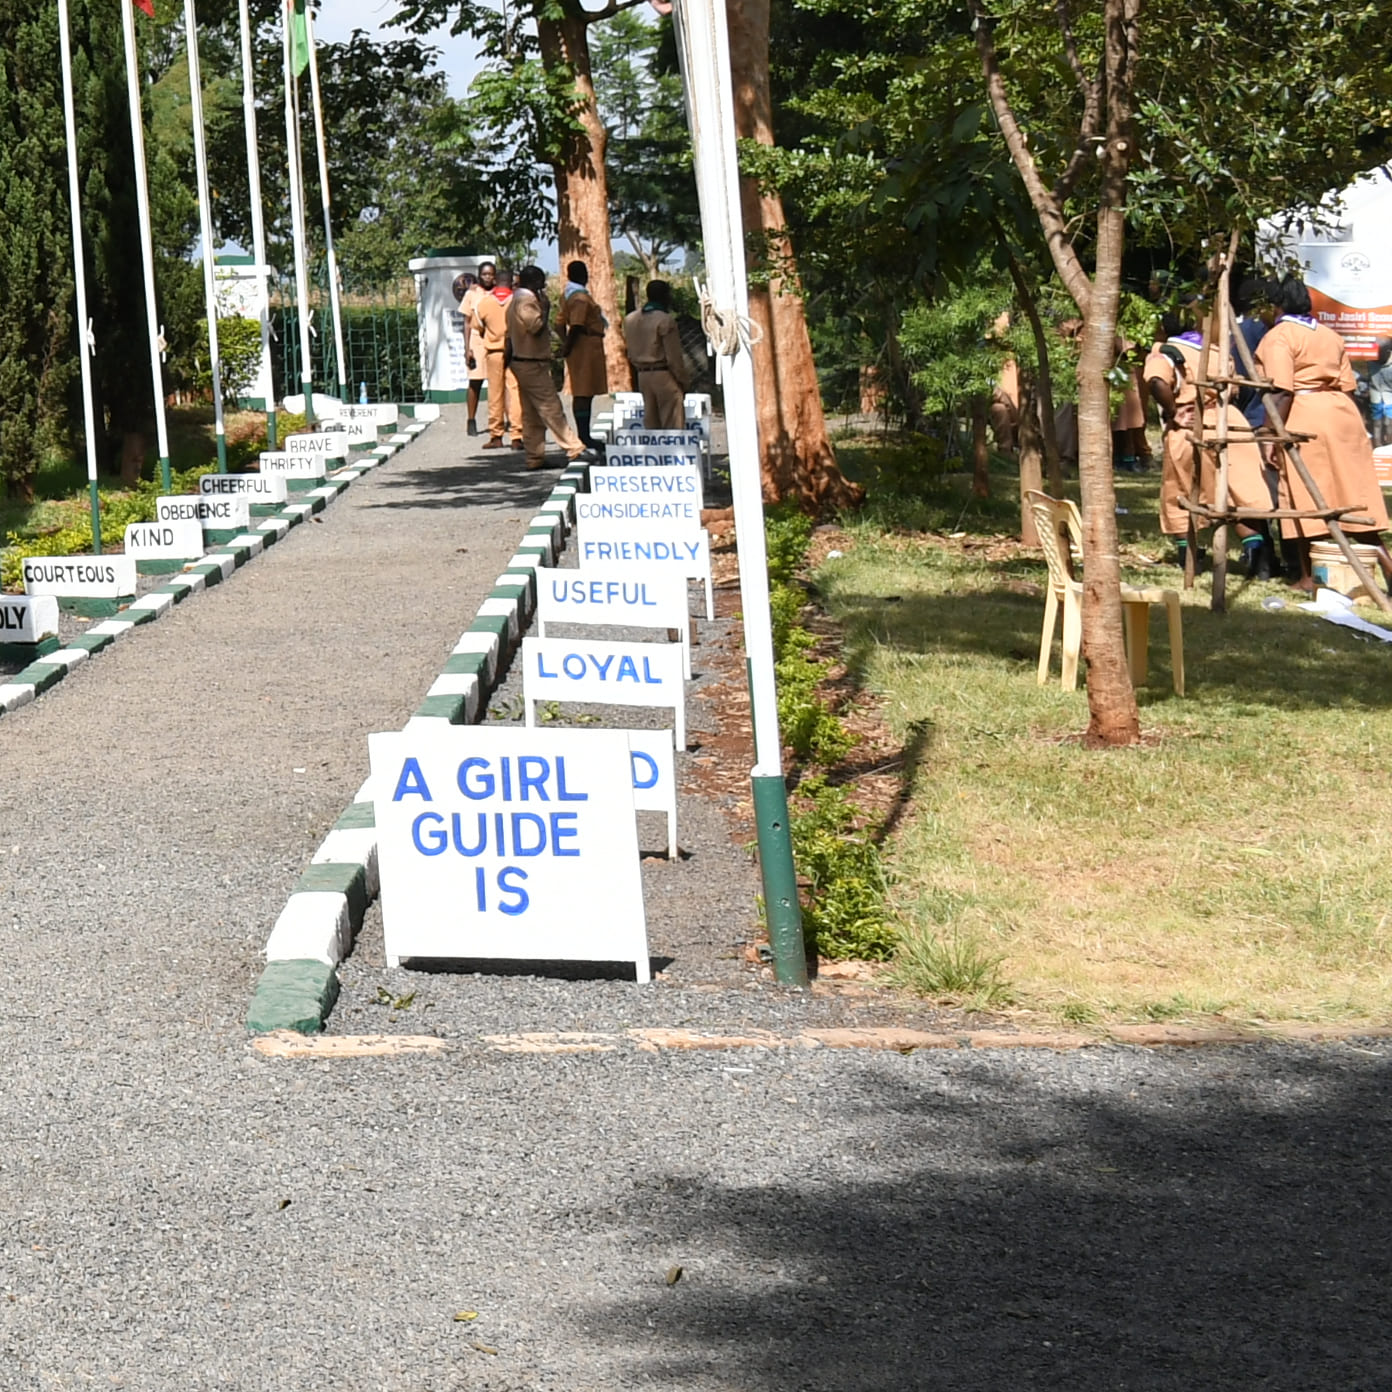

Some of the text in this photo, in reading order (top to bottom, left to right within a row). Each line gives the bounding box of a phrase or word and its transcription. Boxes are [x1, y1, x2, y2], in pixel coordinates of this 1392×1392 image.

[1318, 311, 1336, 321] The
[338, 408, 378, 418] REVERENT
[290, 438, 333, 453] BRAVE
[262, 457, 314, 471] THRIFTY
[609, 454, 696, 466] OBEDIENT
[201, 478, 272, 495] CHEERFUL
[594, 475, 696, 493] PRESERVES
[160, 502, 231, 521] OBEDIENCE
[579, 503, 694, 519] CONSIDERATE
[130, 528, 174, 547] KIND
[584, 541, 700, 561] FRIENDLY
[24, 564, 116, 584] COURTEOUS
[552, 580, 657, 606] USEFUL
[537, 652, 663, 684] LOYAL
[392, 757, 433, 802] A
[456, 755, 589, 802] GIRL
[411, 811, 581, 858] GUIDE
[475, 865, 530, 917] IS
